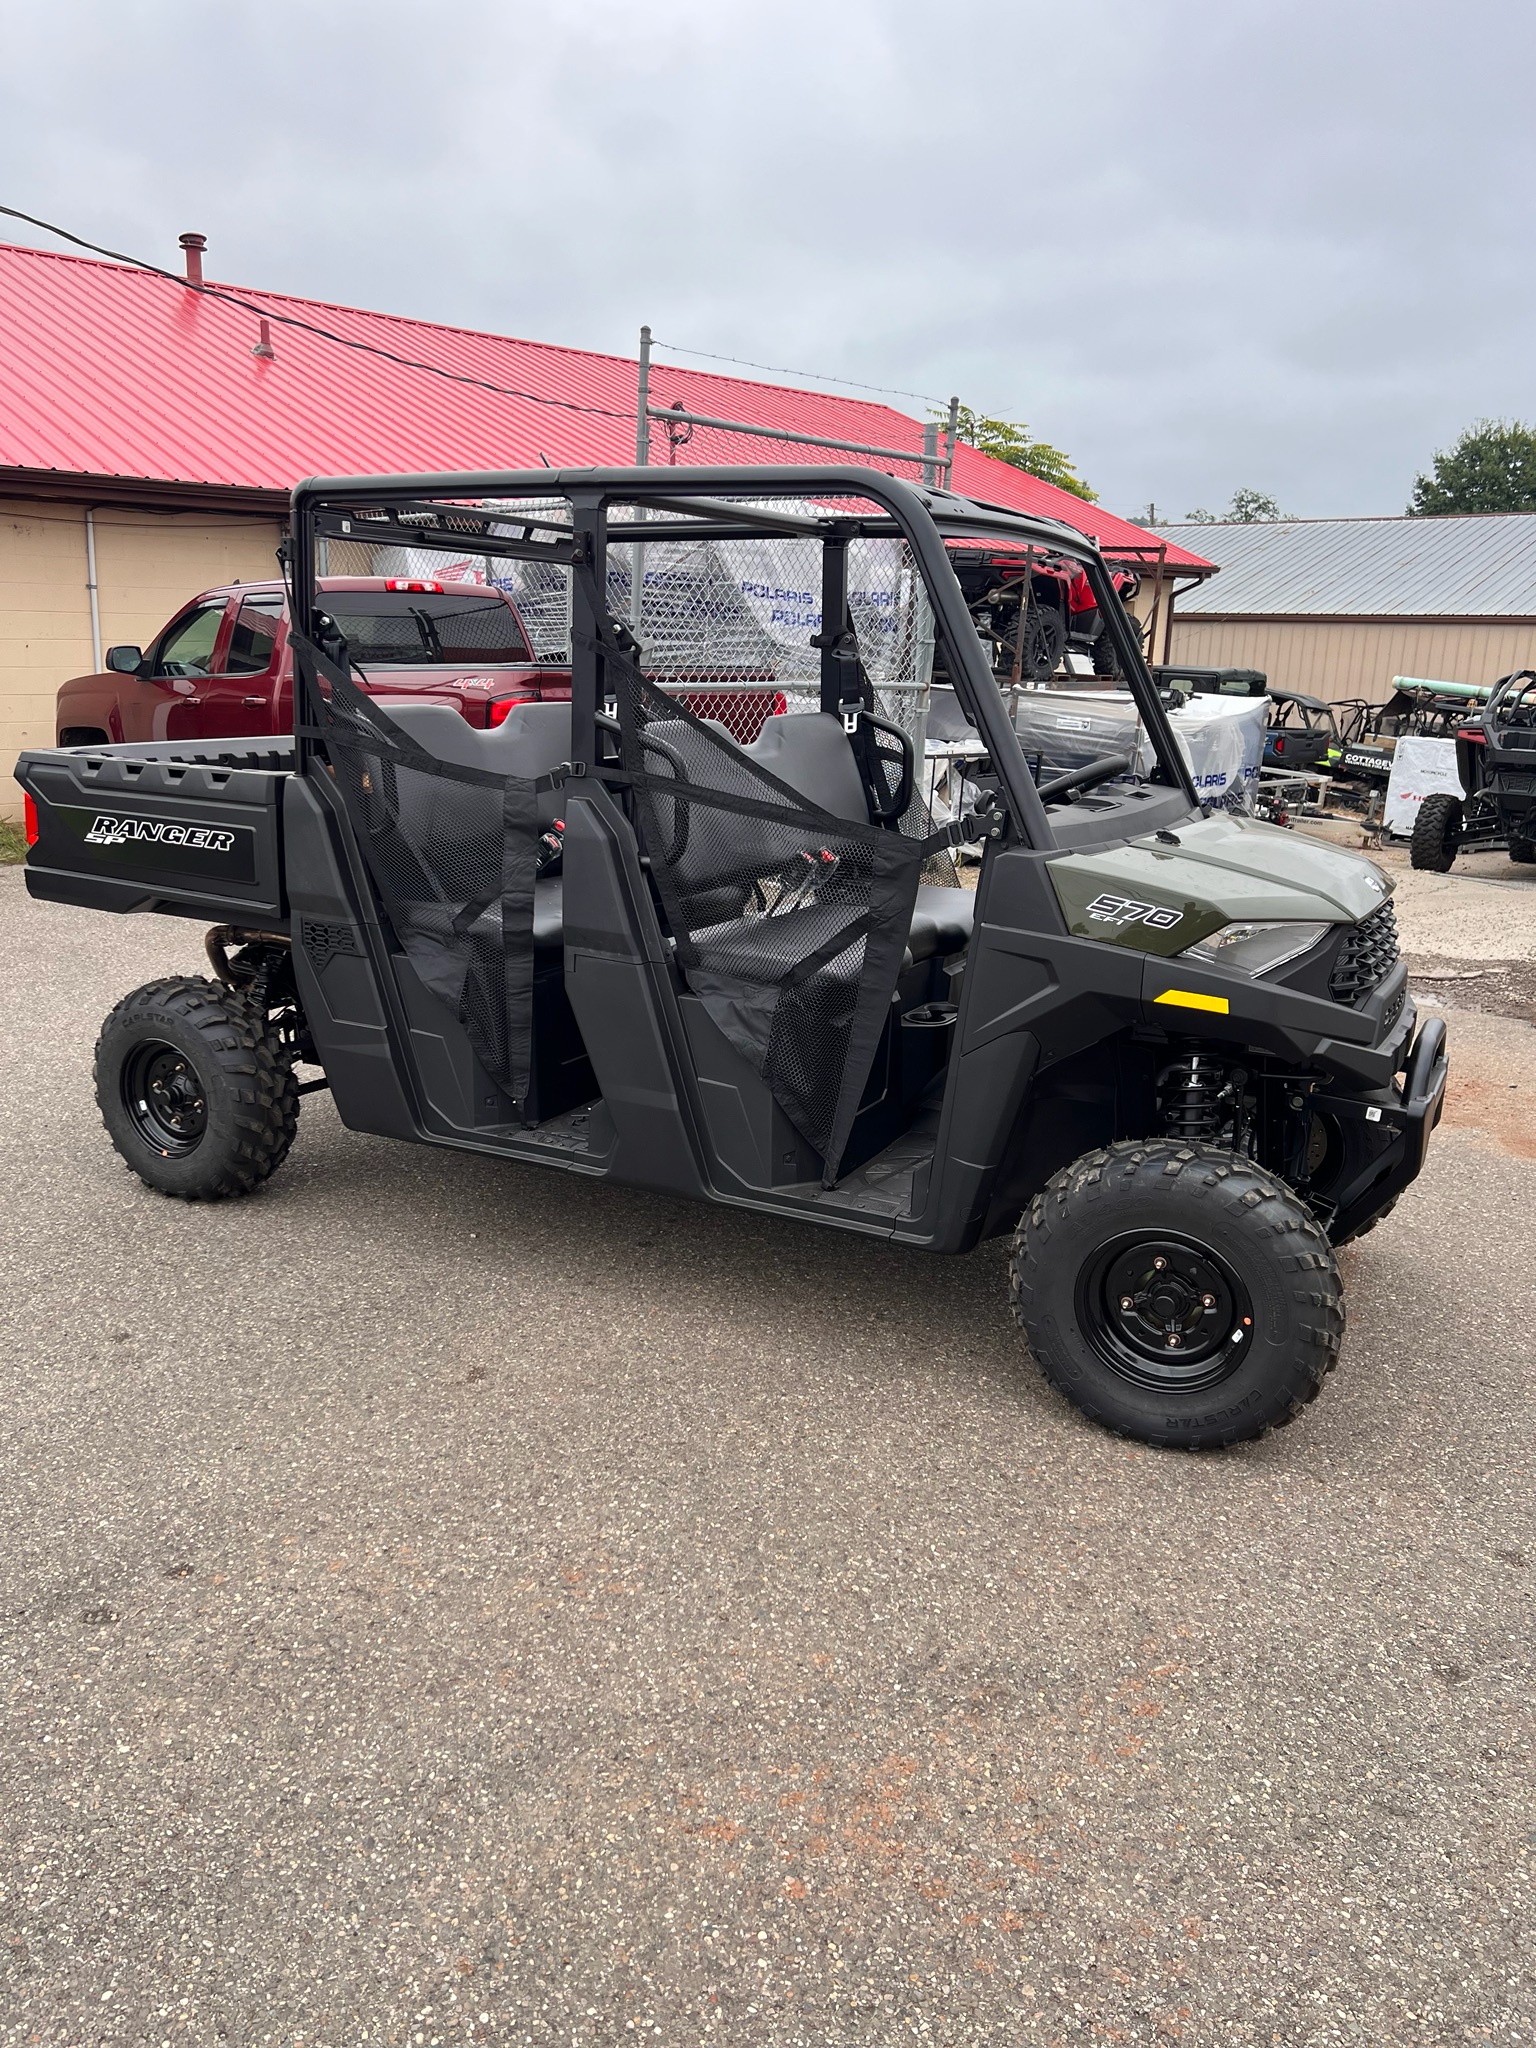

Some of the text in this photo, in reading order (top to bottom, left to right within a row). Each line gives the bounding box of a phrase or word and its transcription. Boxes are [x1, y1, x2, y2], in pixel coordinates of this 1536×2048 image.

[741, 580, 814, 605] POLARIS
[850, 591, 901, 607] OLARIS
[1192, 772, 1227, 788] OLARIS
[84, 833, 126, 845] SP
[91, 816, 235, 851] RANGER
[1086, 893, 1184, 930] 570
[1089, 912, 1124, 926] EFI
[1166, 1388, 1264, 1429] CARLSTAR
